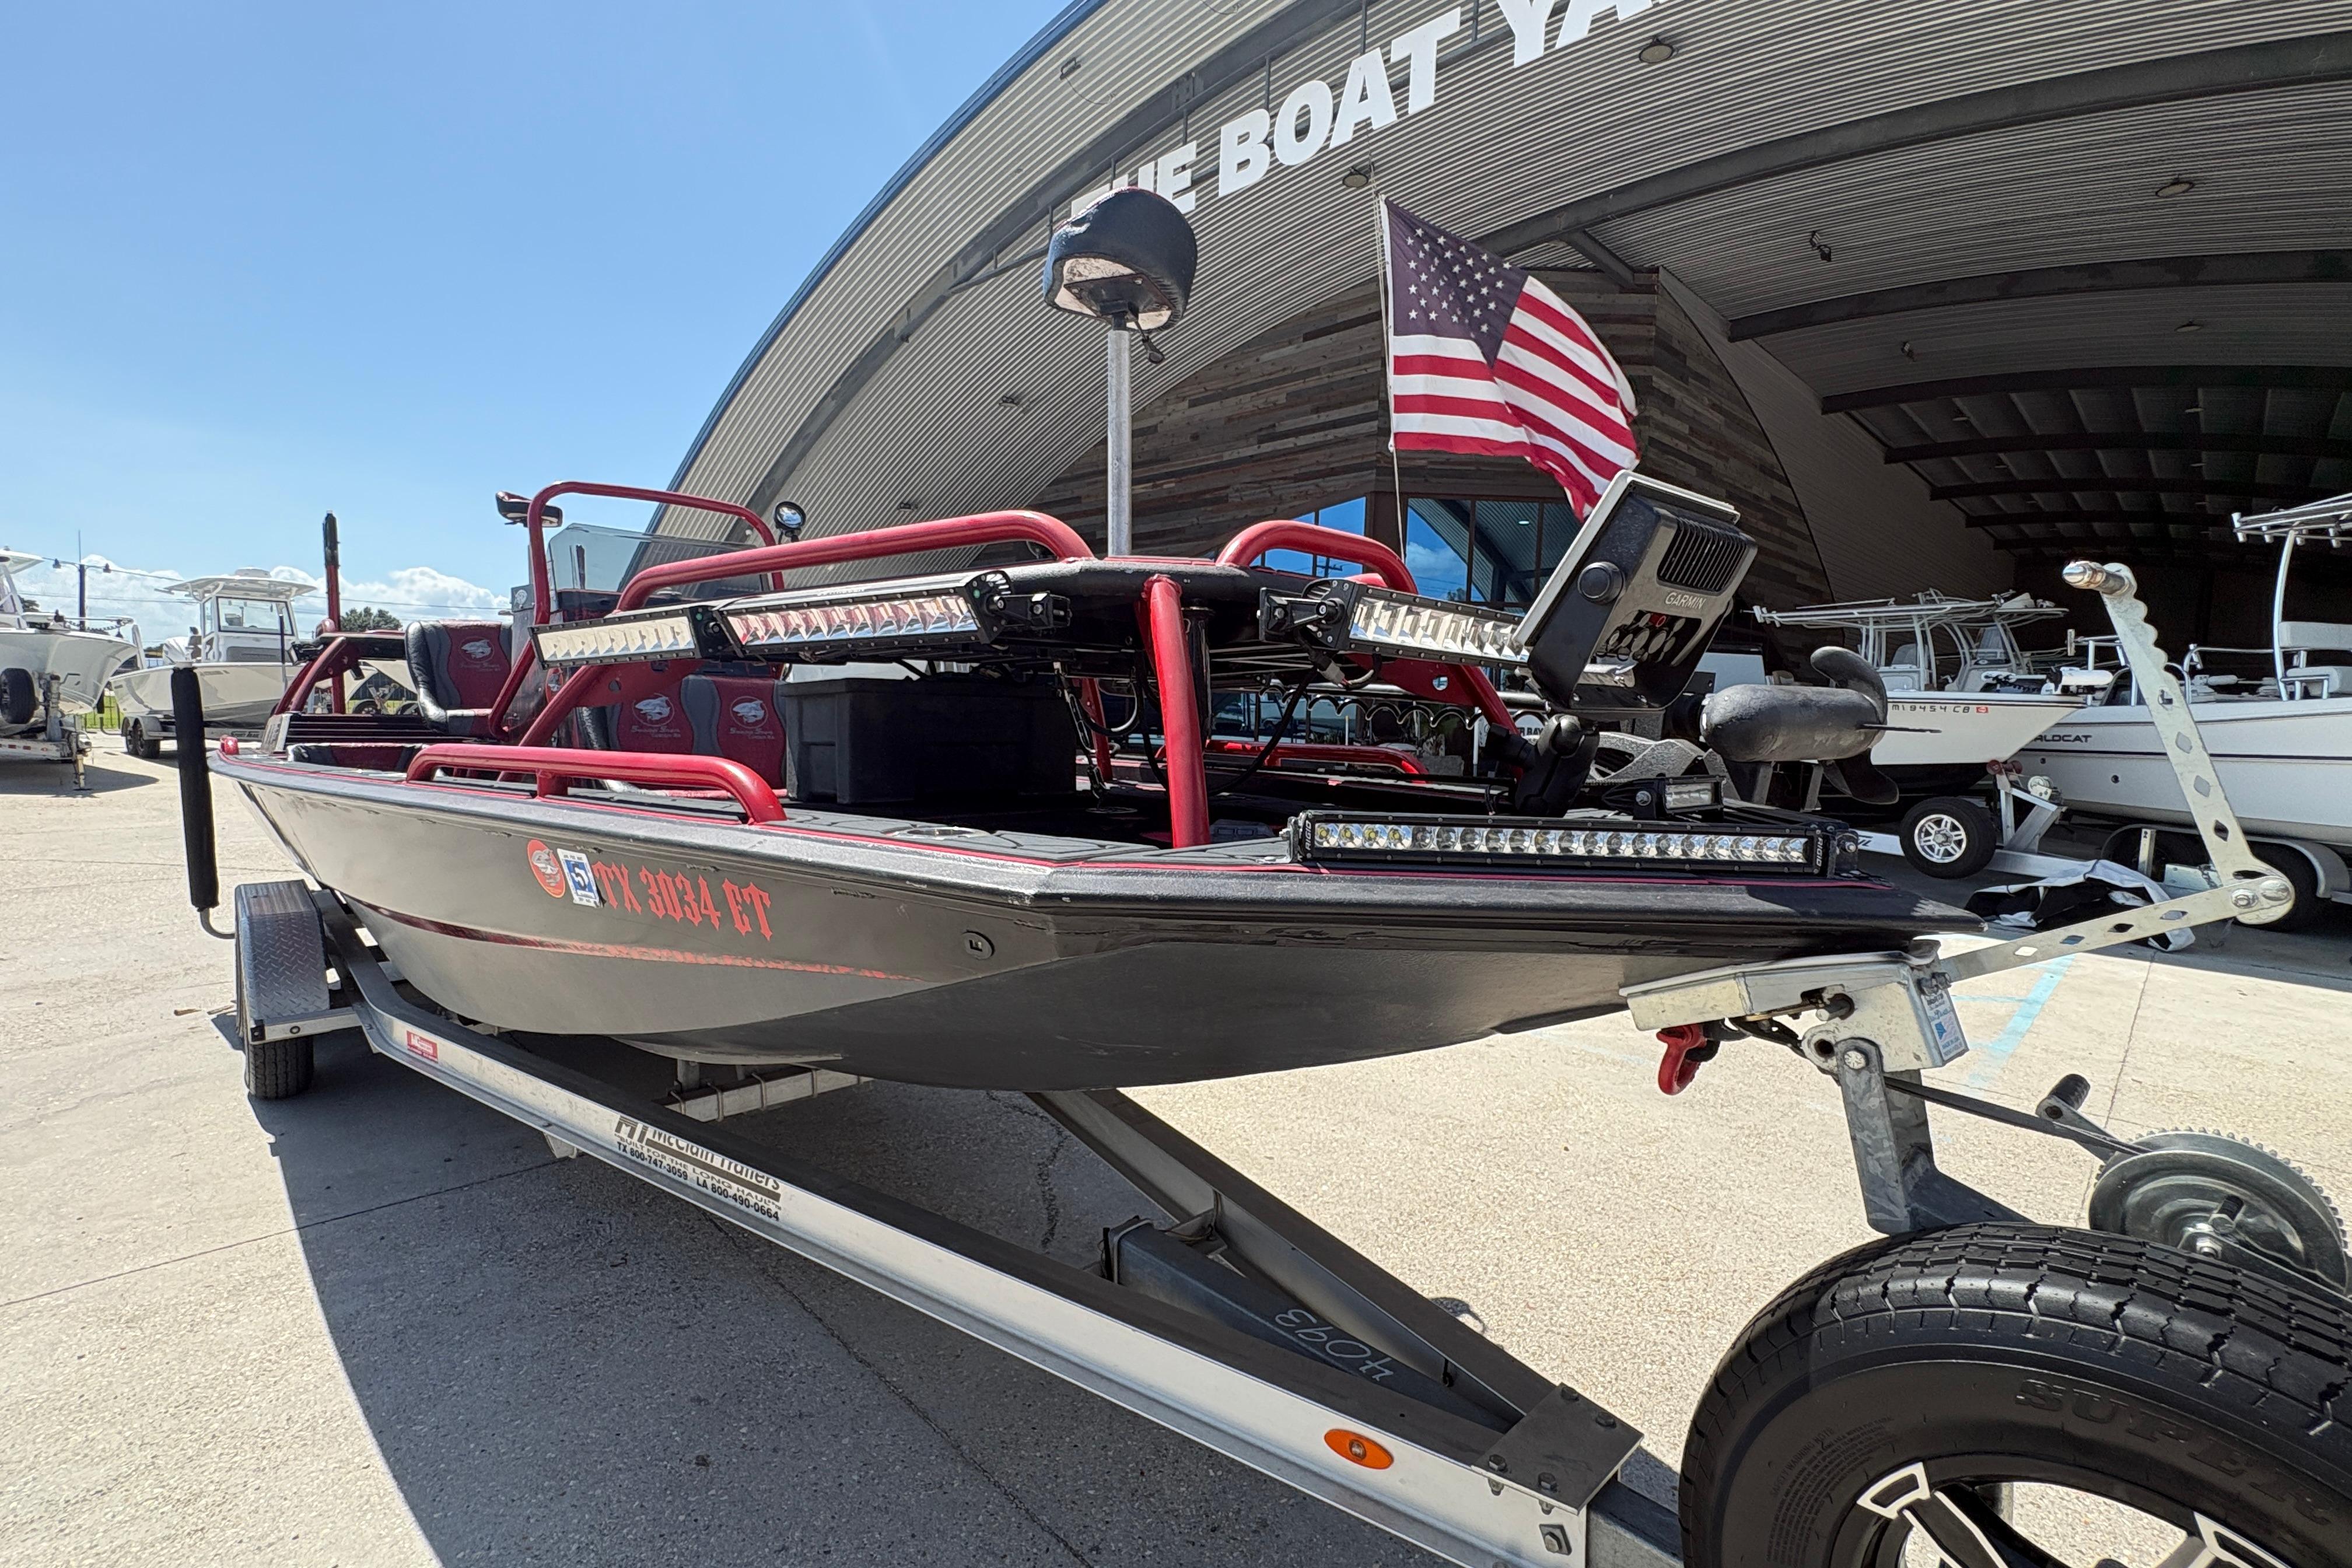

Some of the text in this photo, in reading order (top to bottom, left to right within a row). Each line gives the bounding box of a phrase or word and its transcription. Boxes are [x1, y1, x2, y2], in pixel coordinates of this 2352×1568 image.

[1219, 6, 1461, 197] BOAT
[1665, 592, 1707, 610] GARMIN
[592, 860, 773, 942] TX 3034 ET
[617, 1141, 779, 1221] TX 800-747-3059 LA 800-490-0664
[646, 1148, 667, 1161] FOR
[670, 1157, 689, 1171] THE
[692, 1167, 733, 1190] LONG
